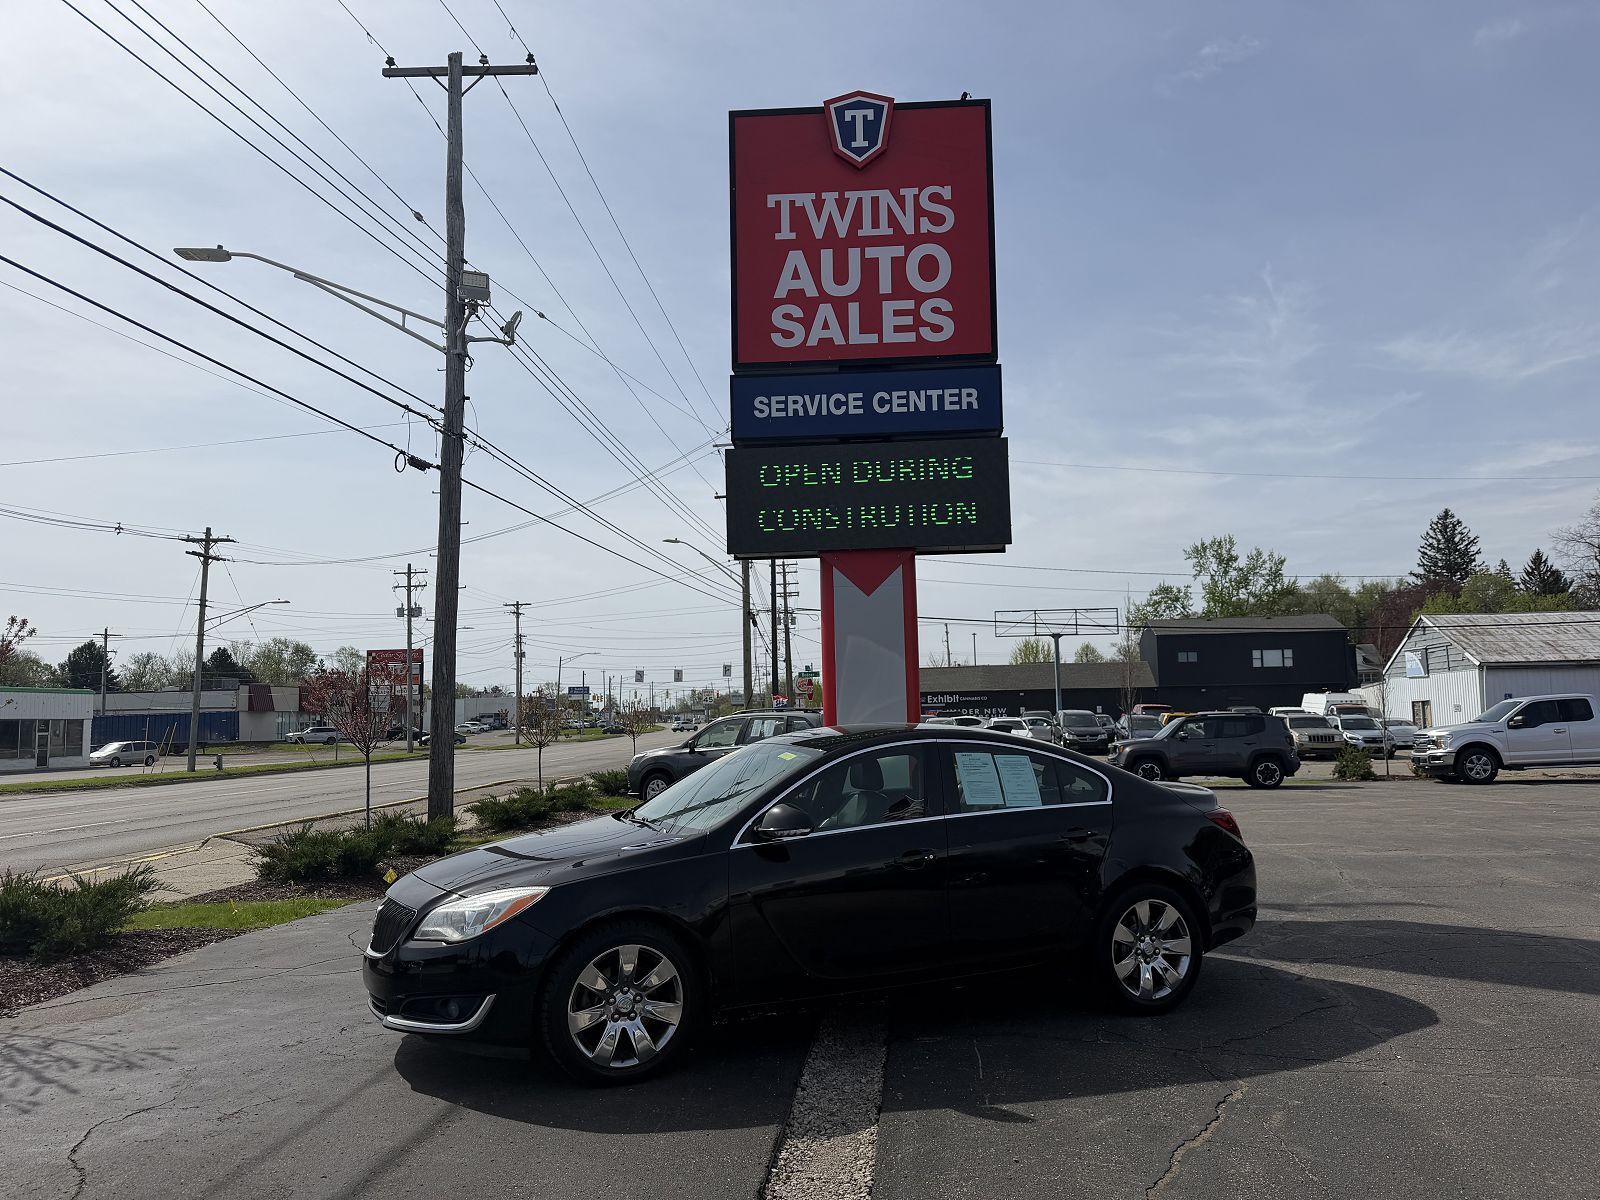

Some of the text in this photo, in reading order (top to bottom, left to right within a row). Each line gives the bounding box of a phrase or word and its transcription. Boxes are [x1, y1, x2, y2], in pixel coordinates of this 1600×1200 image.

[844, 107, 875, 149] T
[766, 185, 955, 241] TWINS
[773, 243, 953, 300] AUTO
[770, 297, 956, 349] SALES
[752, 387, 980, 420] SERVICE CENTER
[759, 456, 974, 487] OPEN DURING
[927, 695, 960, 704] Exhibit
[984, 707, 1008, 715] NEW
